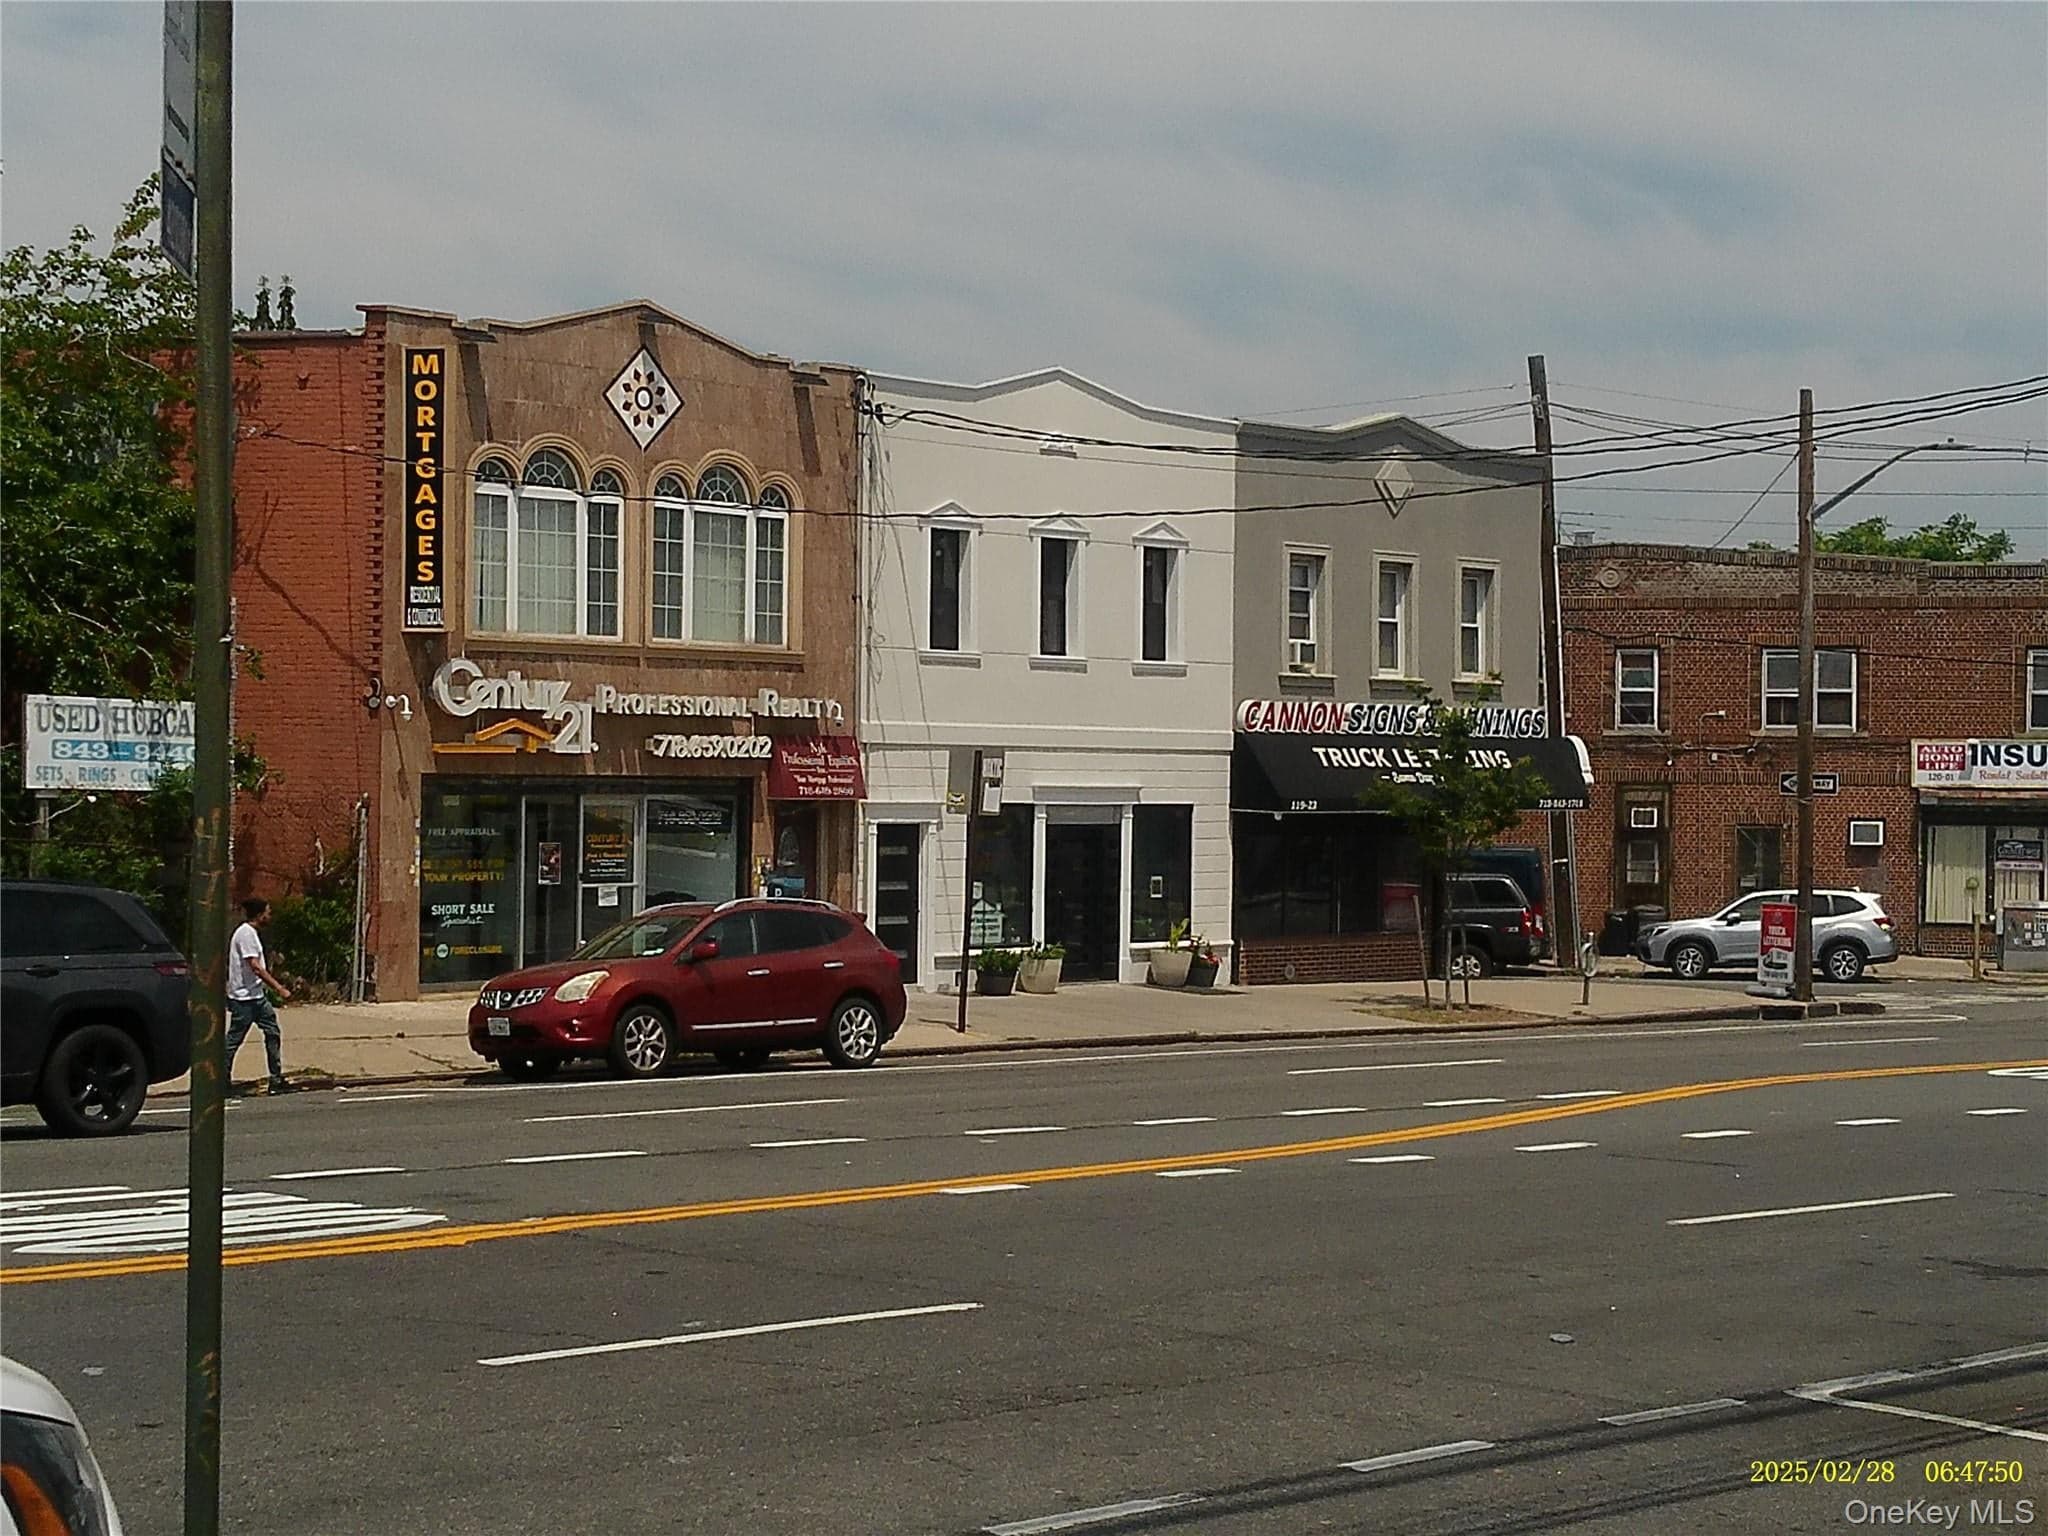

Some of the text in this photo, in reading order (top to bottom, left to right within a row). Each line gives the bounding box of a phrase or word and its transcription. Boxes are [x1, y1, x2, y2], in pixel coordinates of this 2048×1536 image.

[412, 354, 439, 582] MORTGAGES
[433, 657, 571, 720] Century
[597, 685, 836, 719] PROFESSIONAL REALTY
[35, 703, 195, 737] USED HUBCA
[1244, 701, 1345, 732] CANNON
[1348, 704, 1419, 735] SIGNS
[1444, 708, 1547, 738] NINGS
[1312, 747, 1392, 768] TRUCK
[1919, 753, 1964, 762] HOME
[1921, 745, 1963, 753] AUTO
[1969, 743, 2048, 767] INSU
[36, 765, 63, 781] SETS
[78, 767, 116, 782] RINGS
[1925, 762, 1959, 770] LIFE
[1928, 773, 1955, 781] 120-01
[431, 903, 496, 916] SHORT SALE
